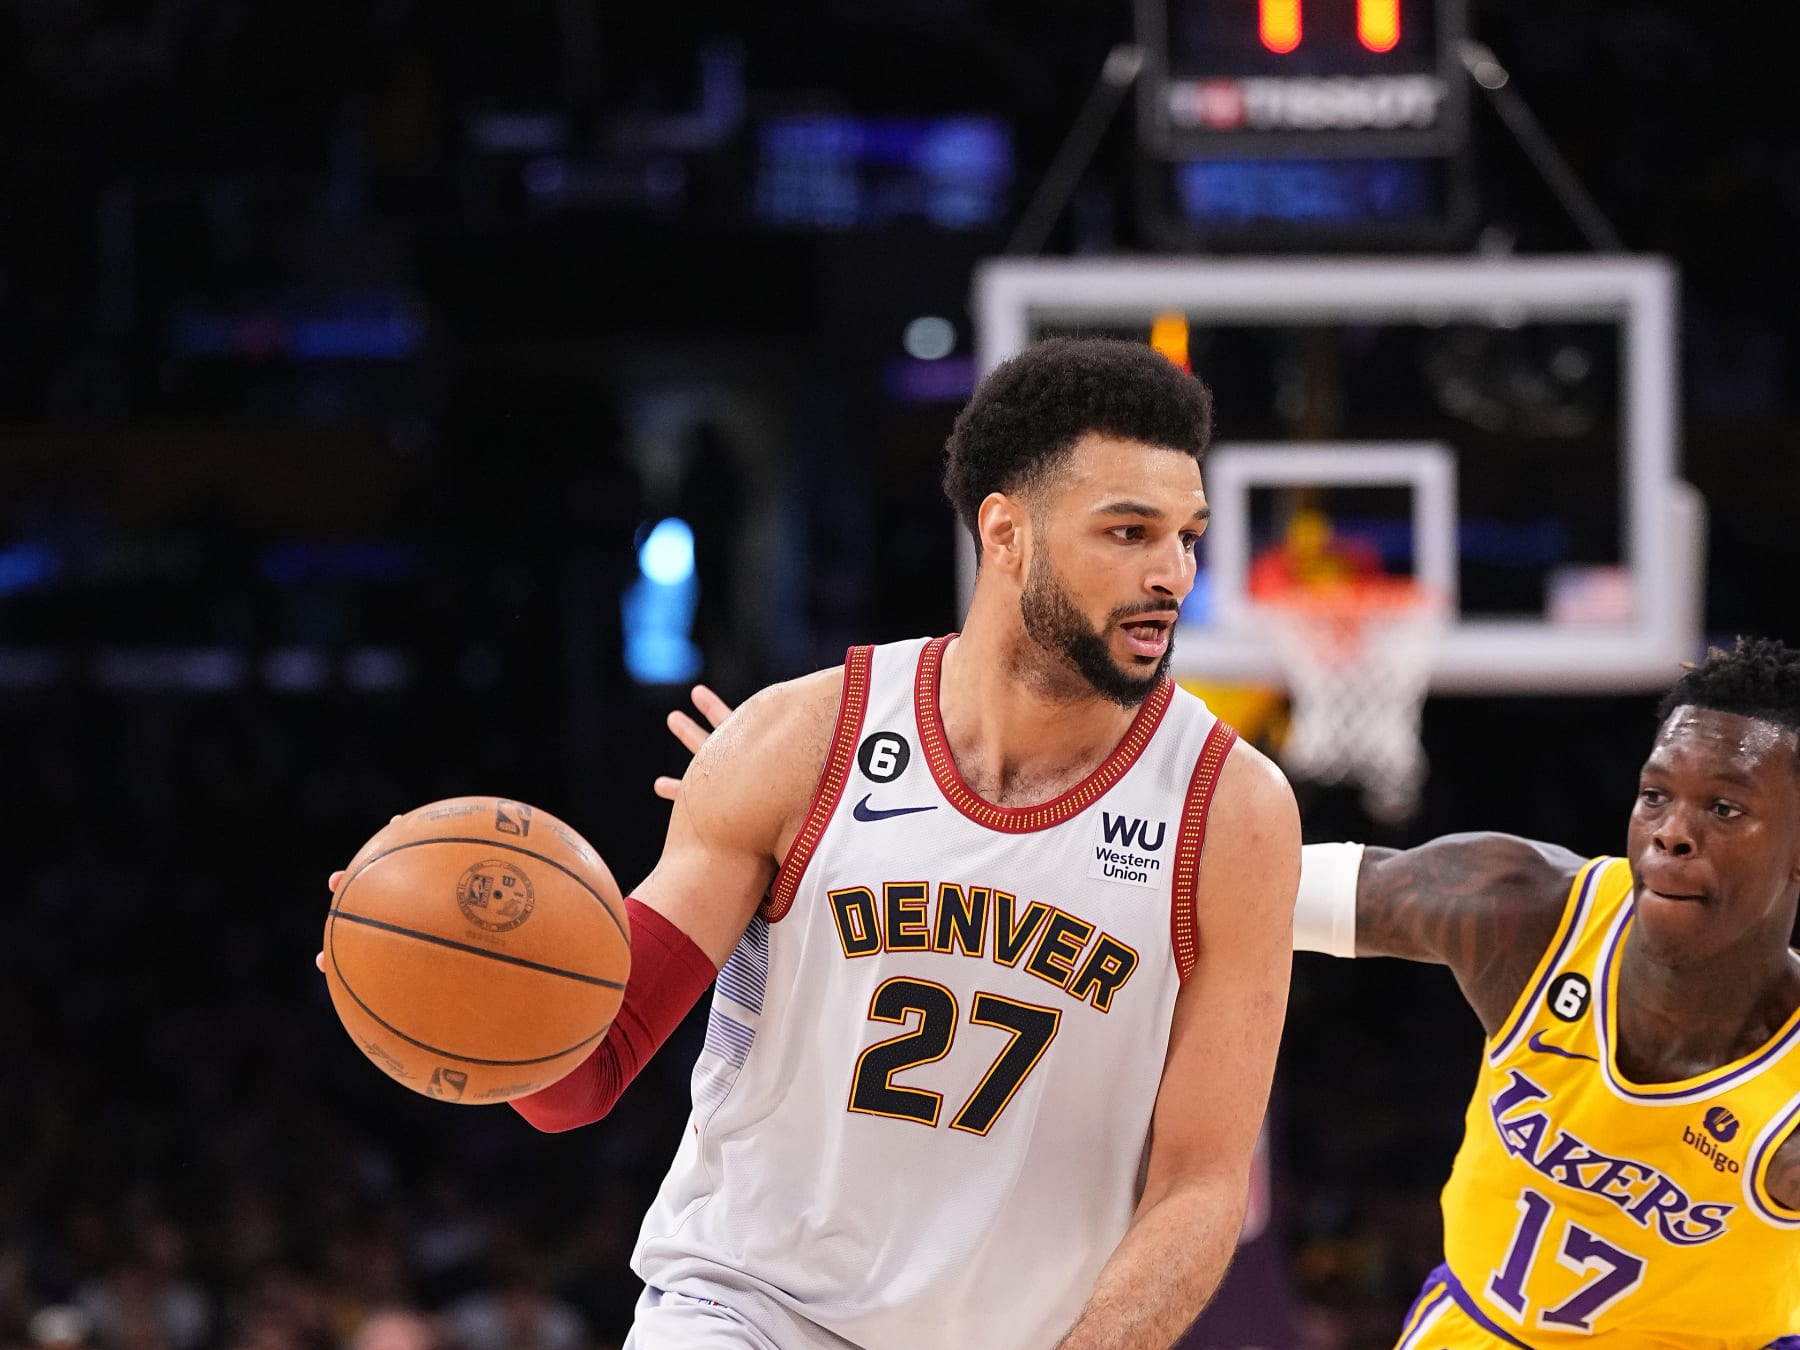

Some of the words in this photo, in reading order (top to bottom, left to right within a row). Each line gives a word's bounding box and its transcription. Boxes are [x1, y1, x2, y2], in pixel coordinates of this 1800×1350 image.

[869, 738, 900, 777] 6
[1102, 811, 1166, 852] WU
[1096, 846, 1160, 870] Western
[1103, 863, 1148, 883] Union
[828, 881, 1140, 1013] DENVER
[1555, 978, 1587, 1018] 6
[848, 976, 1063, 1136] 27
[1490, 1069, 1738, 1246] LAKERS
[1682, 1125, 1739, 1174] bibigo
[1485, 1188, 1648, 1334] 17
